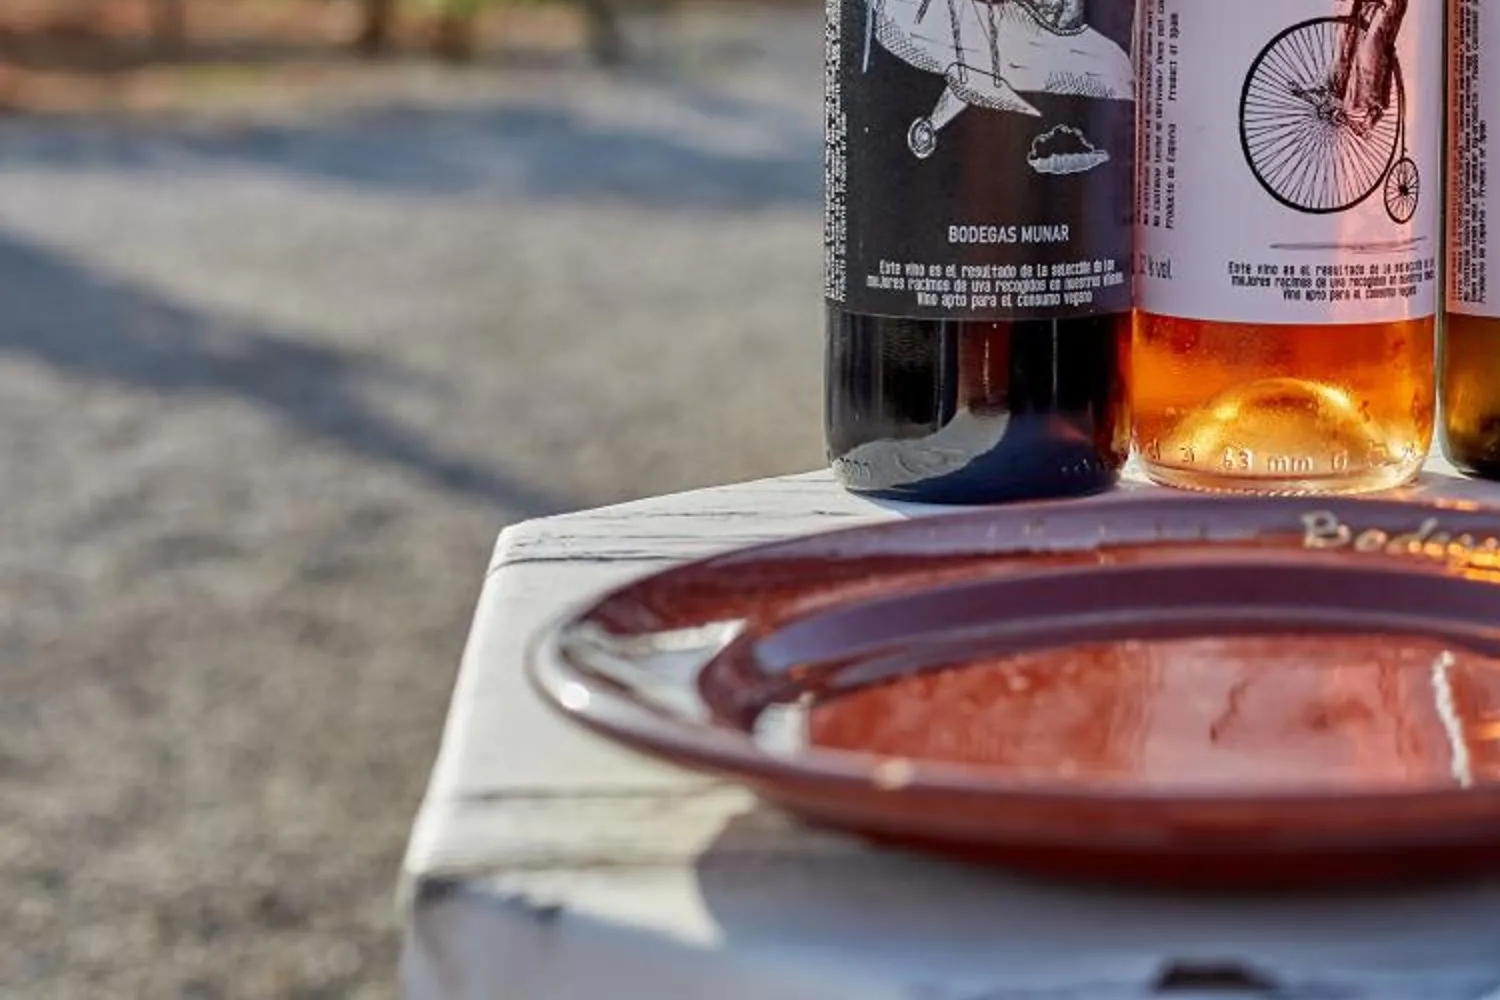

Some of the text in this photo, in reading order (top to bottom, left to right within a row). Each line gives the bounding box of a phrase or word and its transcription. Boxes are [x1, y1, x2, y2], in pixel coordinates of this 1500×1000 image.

[948, 224, 1069, 243] BODEGAS MUNAR
[880, 260, 900, 274] Este
[929, 265, 942, 276] es
[945, 264, 956, 278] el
[961, 264, 1017, 278] resultado
[1020, 264, 1033, 278] de
[1037, 263, 1048, 278] la
[908, 278, 950, 292] racimos
[953, 279, 967, 292] de
[972, 280, 991, 293] uva
[995, 279, 1046, 294] recogidos
[942, 293, 967, 309] apto
[971, 294, 997, 311] para
[1001, 294, 1012, 307] el
